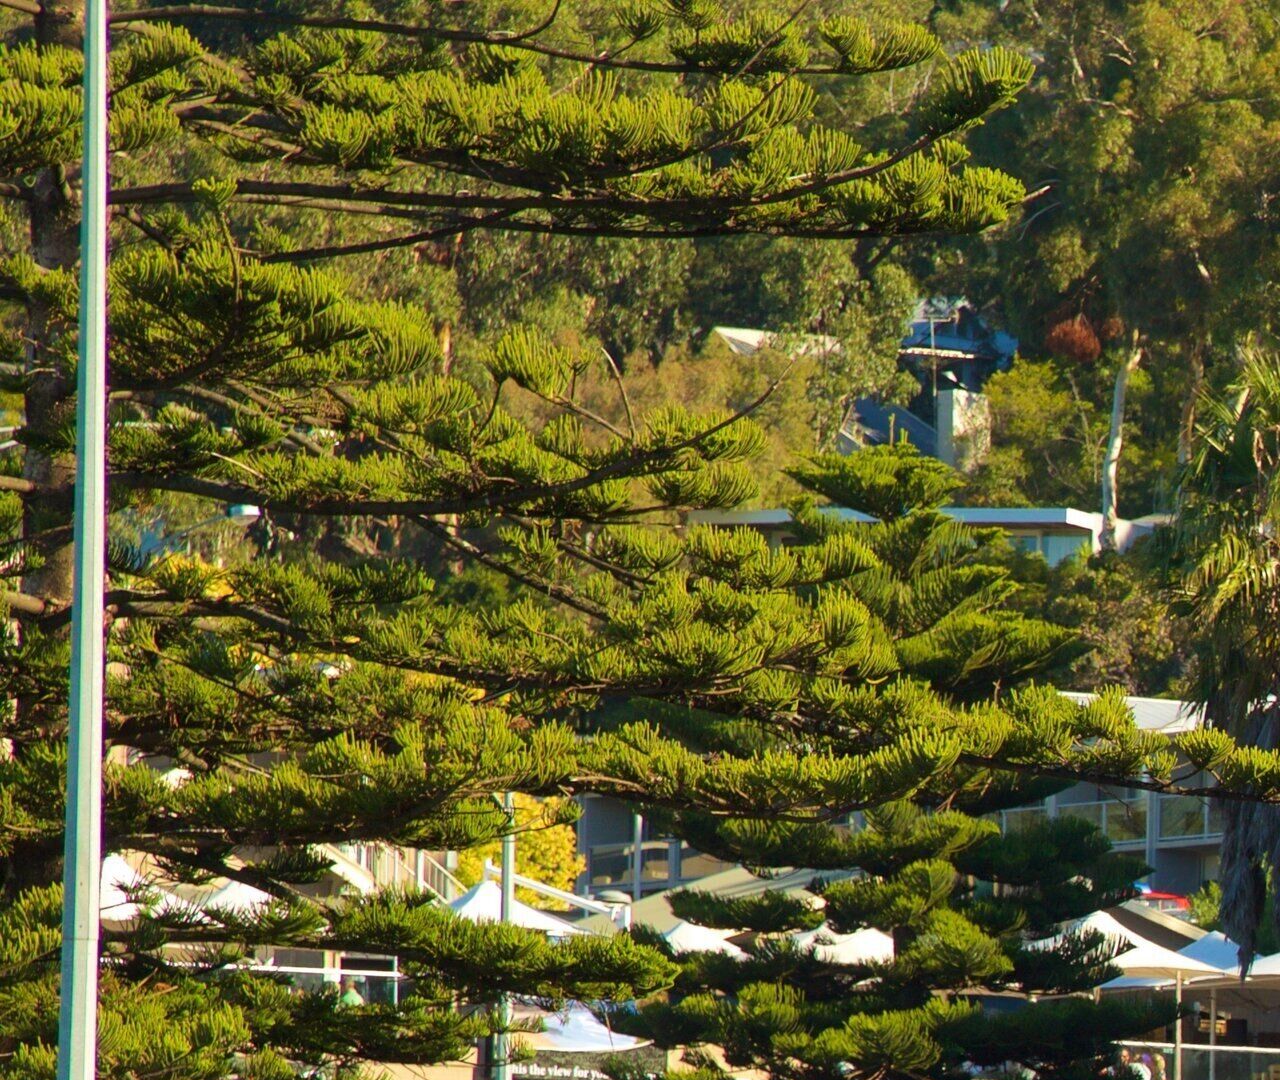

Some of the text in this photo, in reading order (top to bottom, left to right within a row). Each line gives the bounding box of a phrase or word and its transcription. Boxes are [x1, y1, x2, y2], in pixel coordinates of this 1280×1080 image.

[509, 1064, 527, 1075] his
[530, 1064, 546, 1075] the
[548, 1065, 573, 1077] view
[574, 1066, 590, 1079] for
